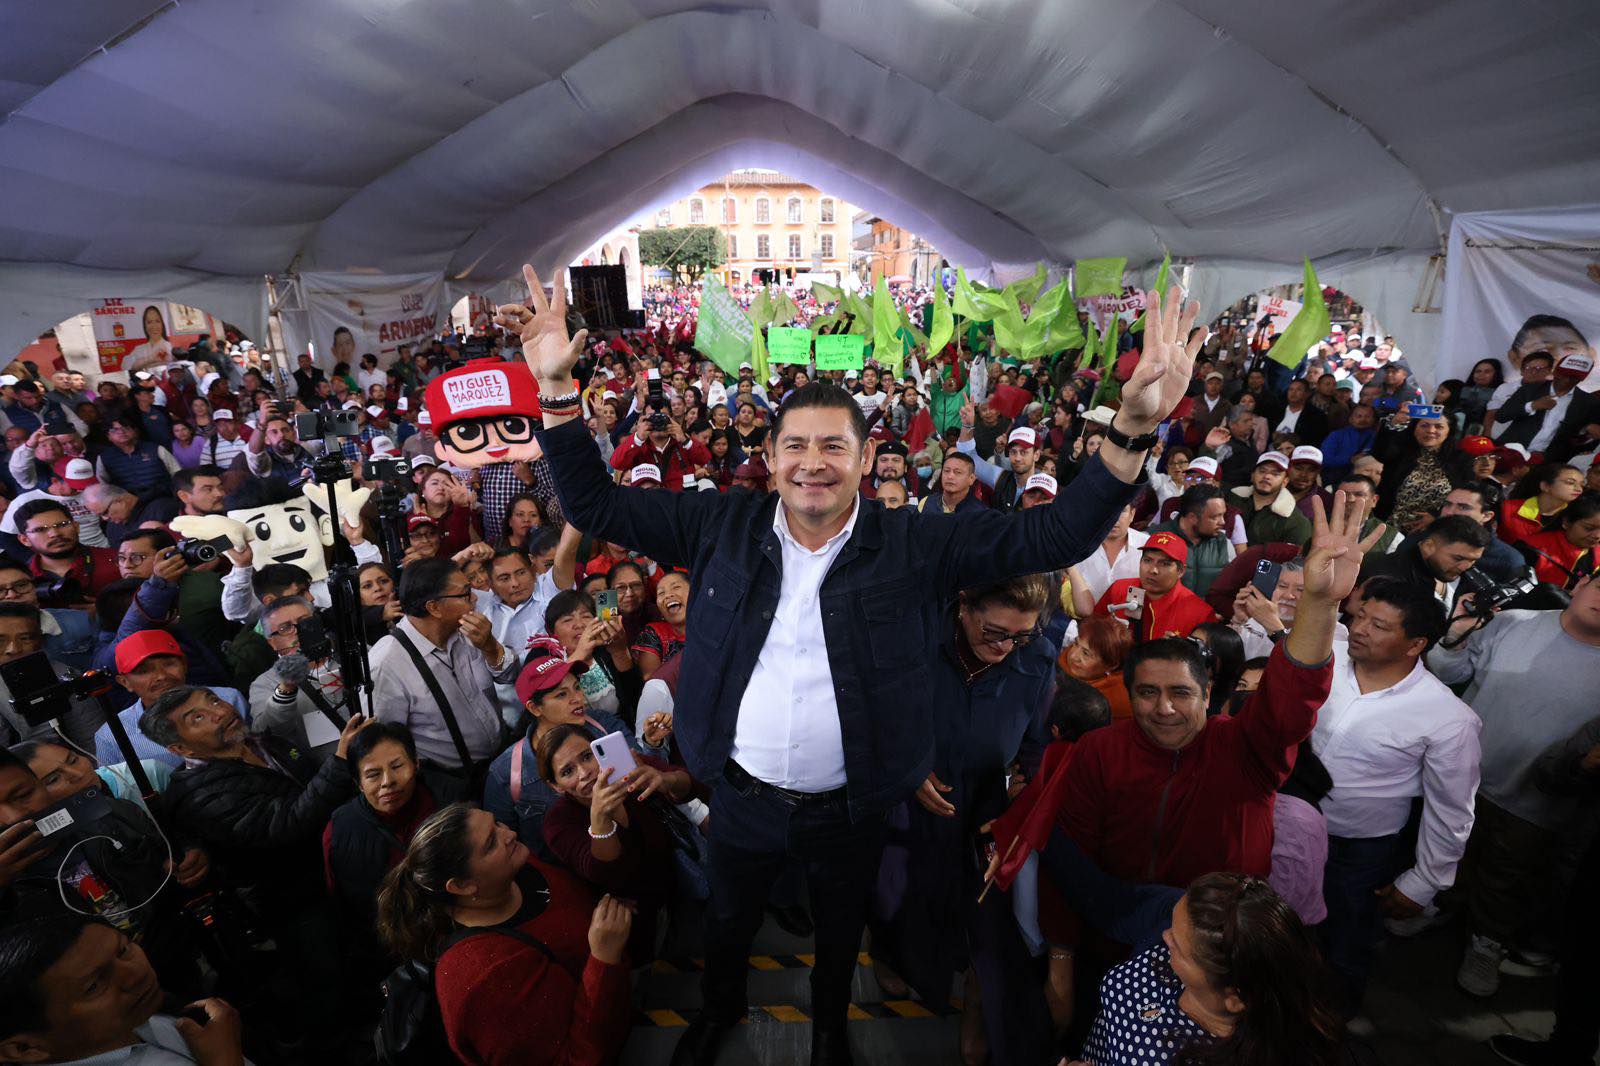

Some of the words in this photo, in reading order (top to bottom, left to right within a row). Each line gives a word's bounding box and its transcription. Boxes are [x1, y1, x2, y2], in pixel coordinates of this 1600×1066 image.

[104, 297, 123, 306] LIZ
[448, 375, 500, 393] MIGUEL
[452, 386, 504, 404] MARQUEZ
